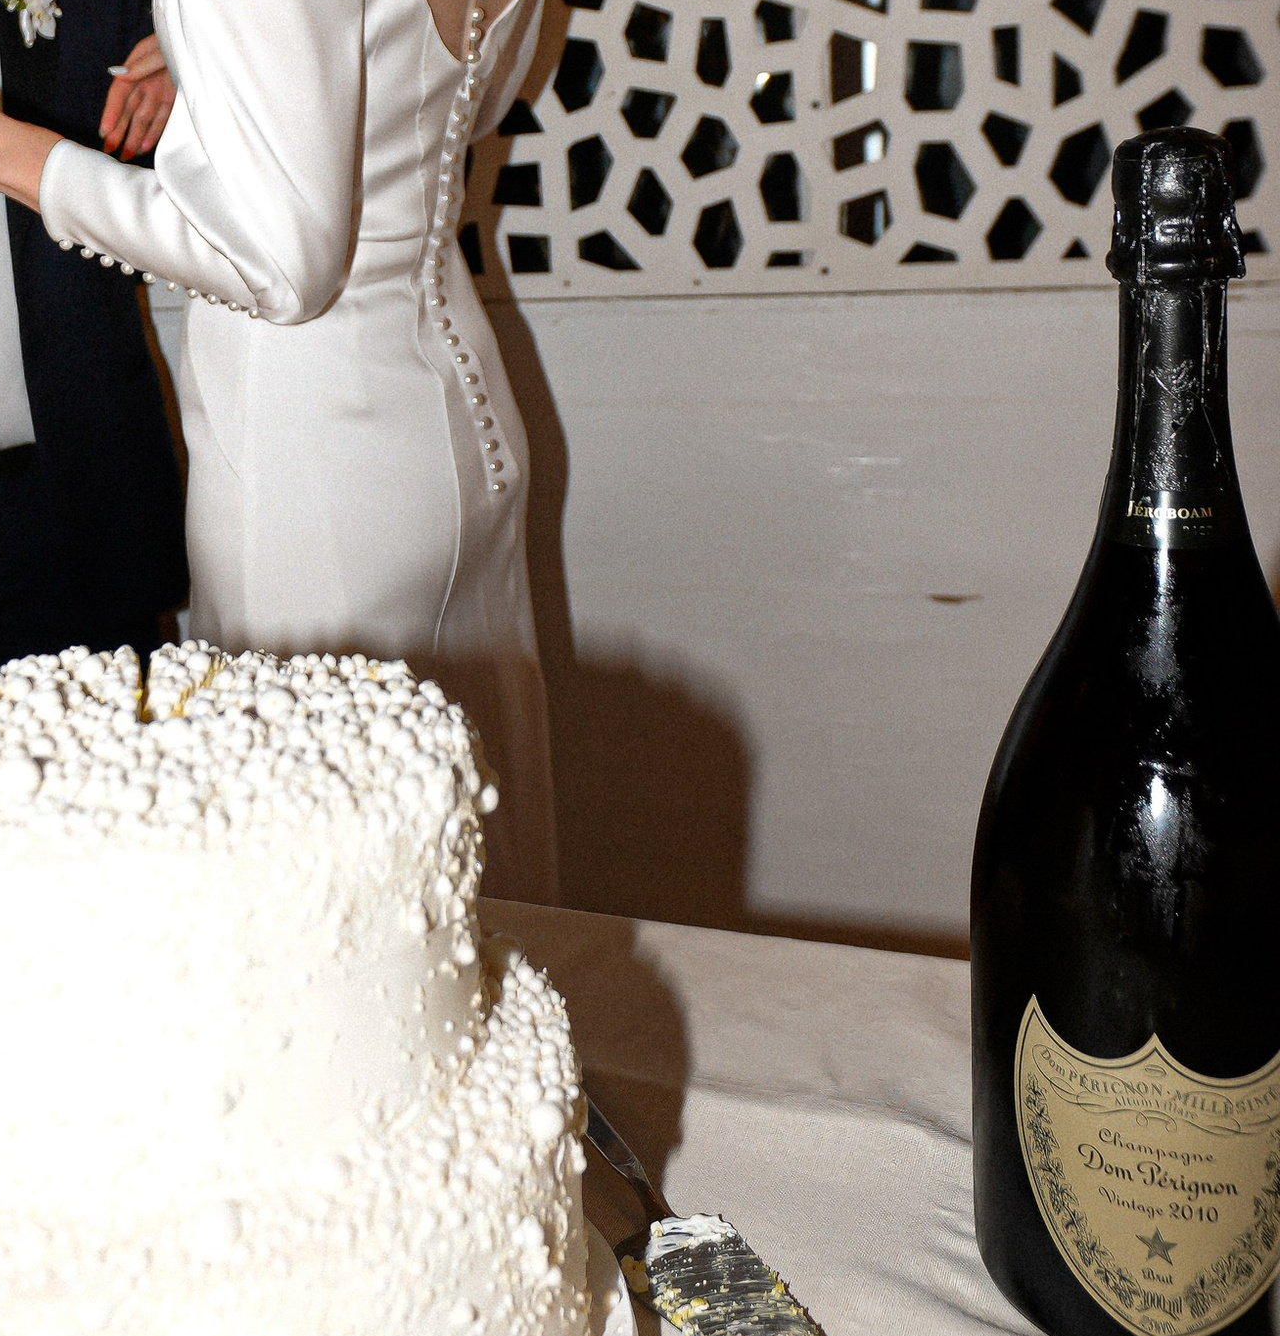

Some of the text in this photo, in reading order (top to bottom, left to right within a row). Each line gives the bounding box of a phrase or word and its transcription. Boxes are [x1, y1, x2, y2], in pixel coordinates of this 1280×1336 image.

[1039, 1046, 1066, 1077] Dom
[1099, 1128, 1214, 1166] Champagne
[1078, 1143, 1238, 1201] Dom Pérignon
[1099, 1186, 1219, 1223] Vintage 2010
[1141, 1266, 1174, 1285] Brut
